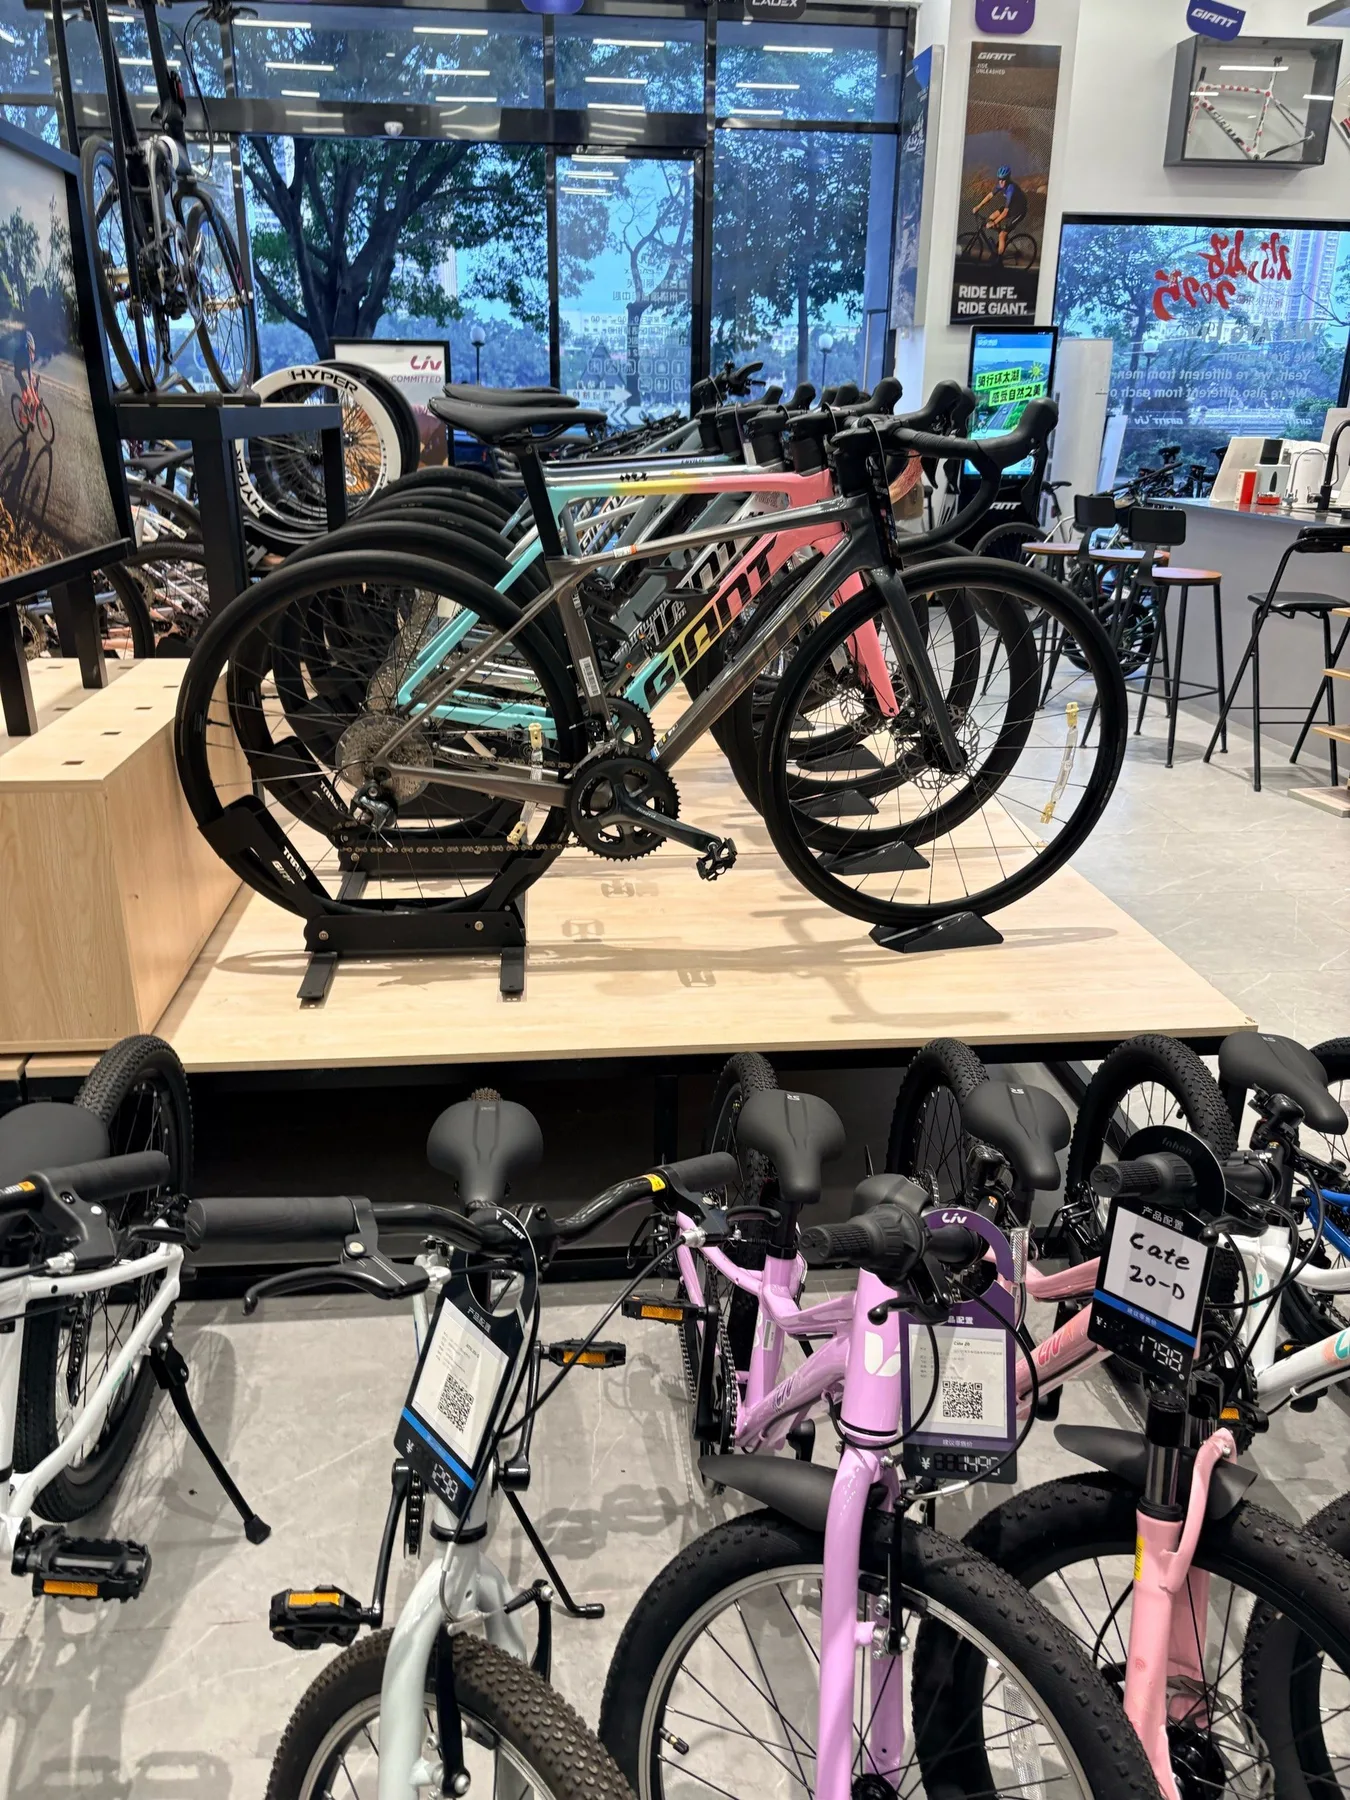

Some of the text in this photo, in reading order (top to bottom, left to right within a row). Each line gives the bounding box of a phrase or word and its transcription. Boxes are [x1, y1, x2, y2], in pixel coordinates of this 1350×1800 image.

[991, 6, 1018, 20] Liv
[1191, 8, 1238, 28] GIANT
[978, 52, 1016, 60] GIANT
[959, 285, 1017, 299] RIDE LIFE.
[957, 301, 1028, 315] RIDE GIANT.
[410, 355, 442, 371] Liv
[290, 369, 358, 394] HYPER
[391, 374, 442, 384] COMMITTED
[989, 502, 1021, 510] ANT
[643, 535, 777, 707] GIANT
[942, 1212, 967, 1224] Liv
[1142, 1205, 1184, 1232] 产品配置
[502, 1219, 526, 1239] GIANT
[1129, 1232, 1190, 1270] Cate
[1129, 1264, 1185, 1300] 20-D
[947, 1315, 974, 1326] 品配置
[1140, 1335, 1183, 1372] 1798
[921, 1457, 931, 1470] ¥
